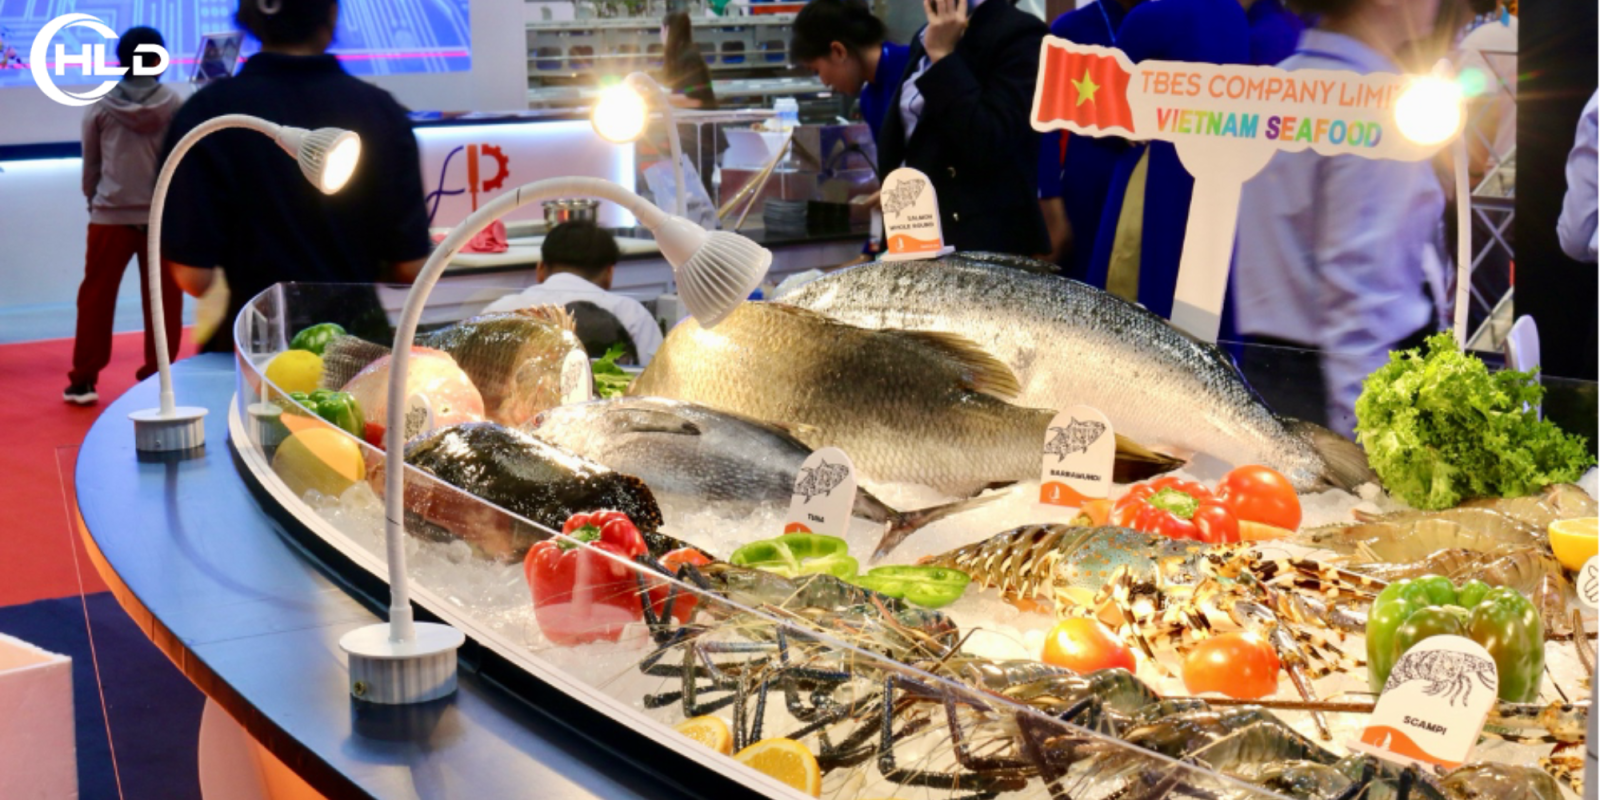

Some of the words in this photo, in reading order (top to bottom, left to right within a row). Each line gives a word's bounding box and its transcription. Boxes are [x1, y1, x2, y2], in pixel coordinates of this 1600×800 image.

[1141, 70, 1202, 97] TBES
[1208, 74, 1335, 105] COMPANY
[1156, 107, 1260, 139] VIETNAM
[1265, 115, 1382, 148] SEAFOOD
[1403, 716, 1447, 735] SCAMPI
